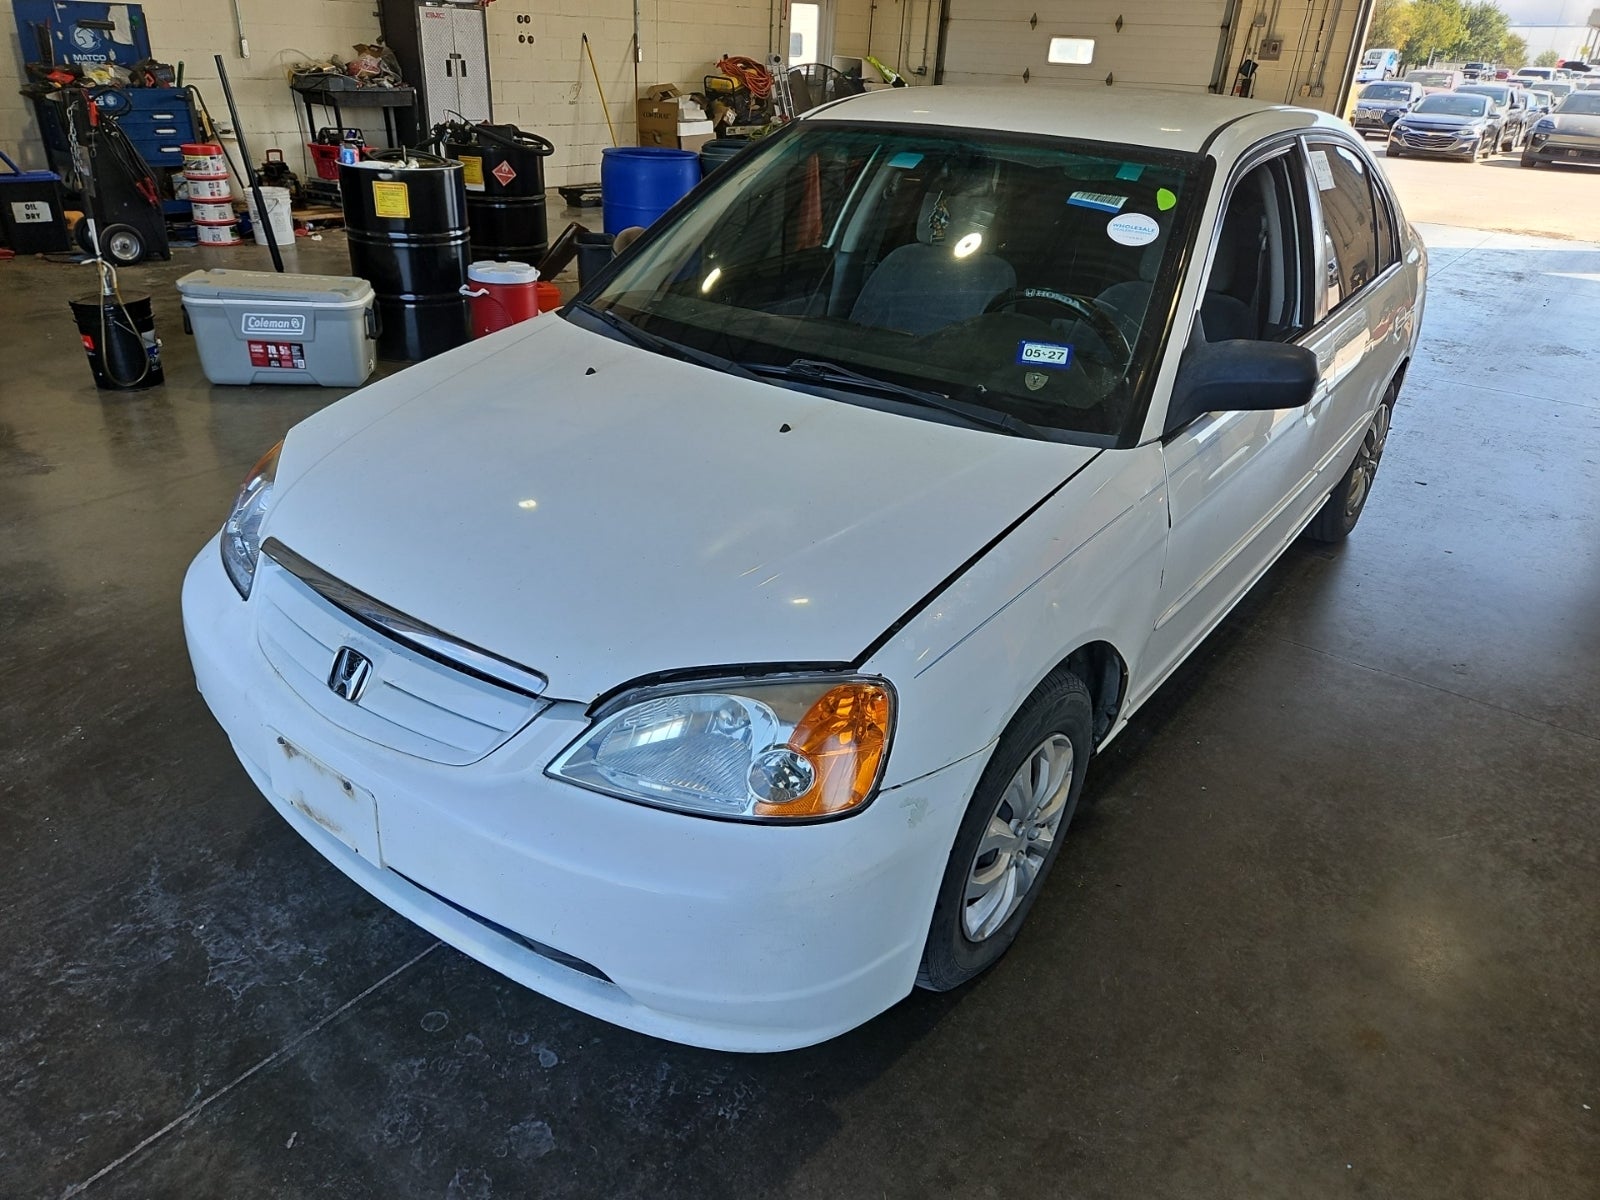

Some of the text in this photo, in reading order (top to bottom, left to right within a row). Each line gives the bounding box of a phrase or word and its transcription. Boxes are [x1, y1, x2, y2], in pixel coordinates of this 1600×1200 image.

[1113, 223, 1156, 233] WHOLESALE
[1036, 289, 1081, 309] HONDA
[248, 316, 290, 328] Coleman
[1025, 348, 1065, 360] 05 27
